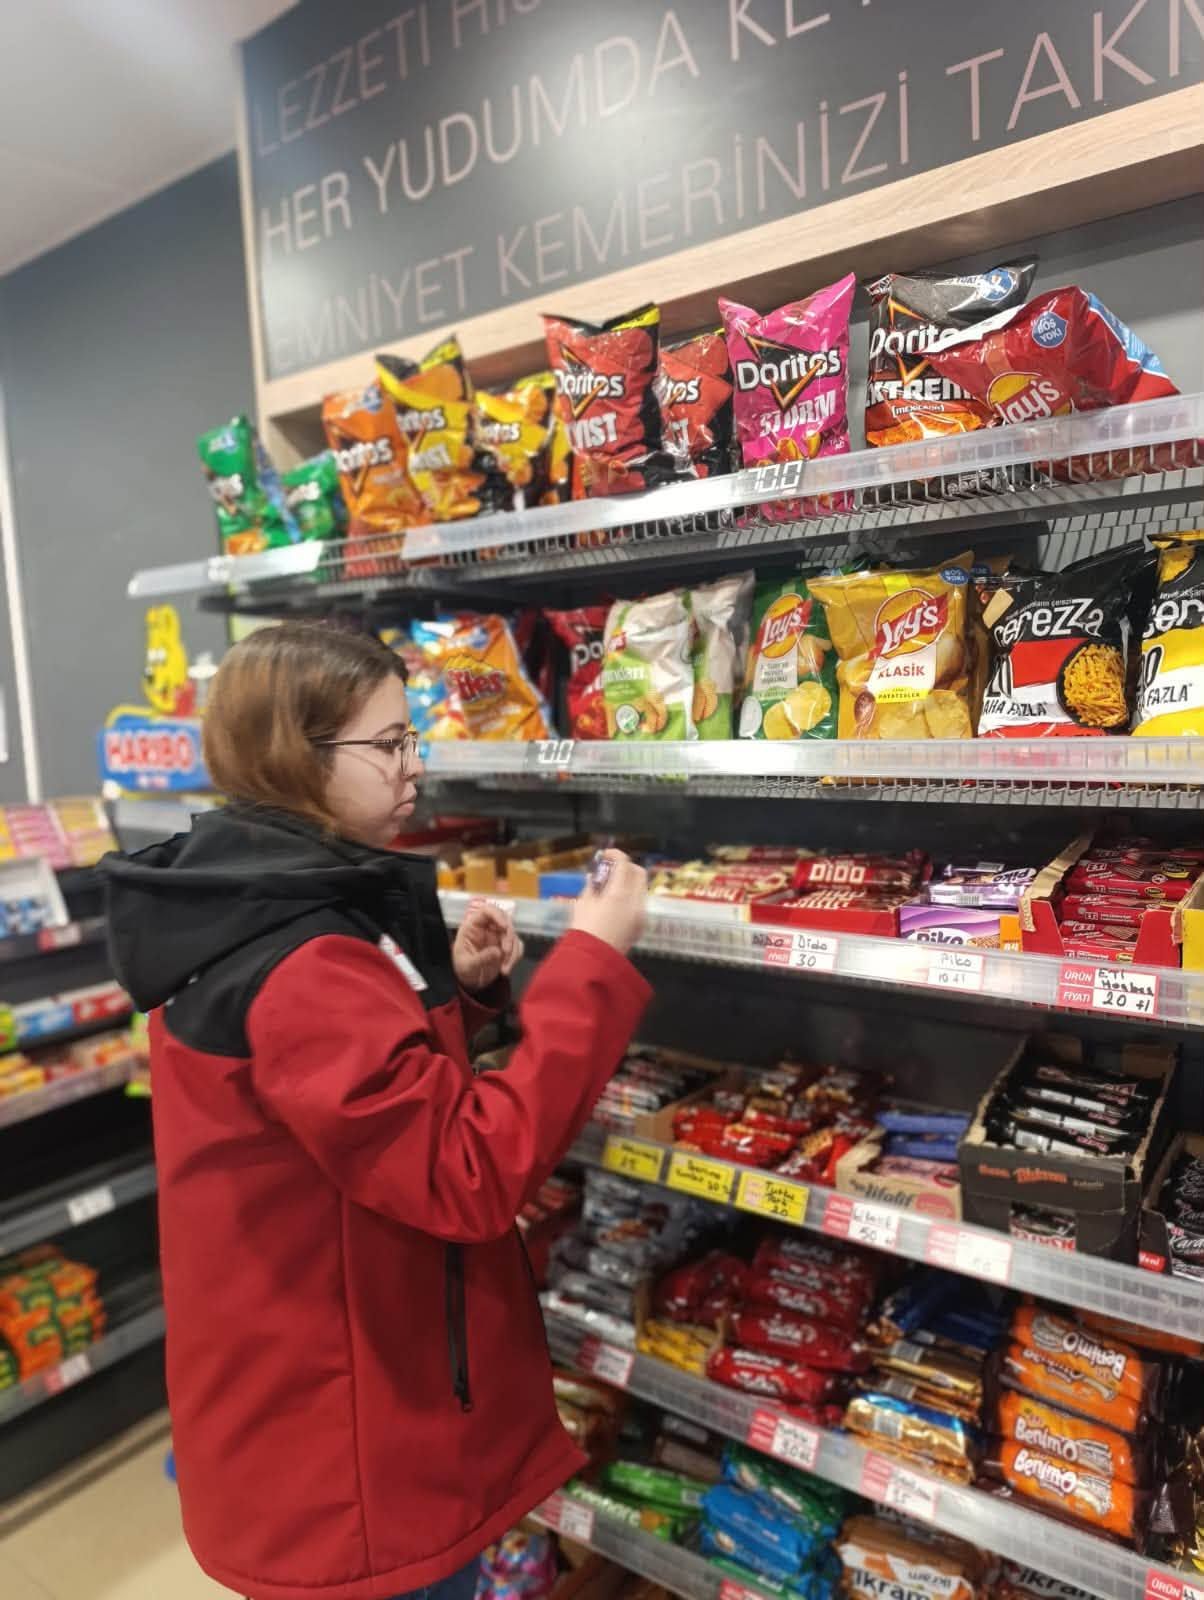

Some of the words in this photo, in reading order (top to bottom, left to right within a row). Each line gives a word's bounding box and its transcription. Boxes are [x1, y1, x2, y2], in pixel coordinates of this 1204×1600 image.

[260, 171, 352, 264] HER
[363, 10, 699, 214] YUDUMDA
[498, 71, 908, 296] KEMERİNİZİ
[738, 350, 841, 391] Doritos
[760, 603, 804, 650] Lay's
[880, 601, 939, 656] Lay's
[796, 953, 817, 967] 30
[1102, 991, 1127, 1007] 20
